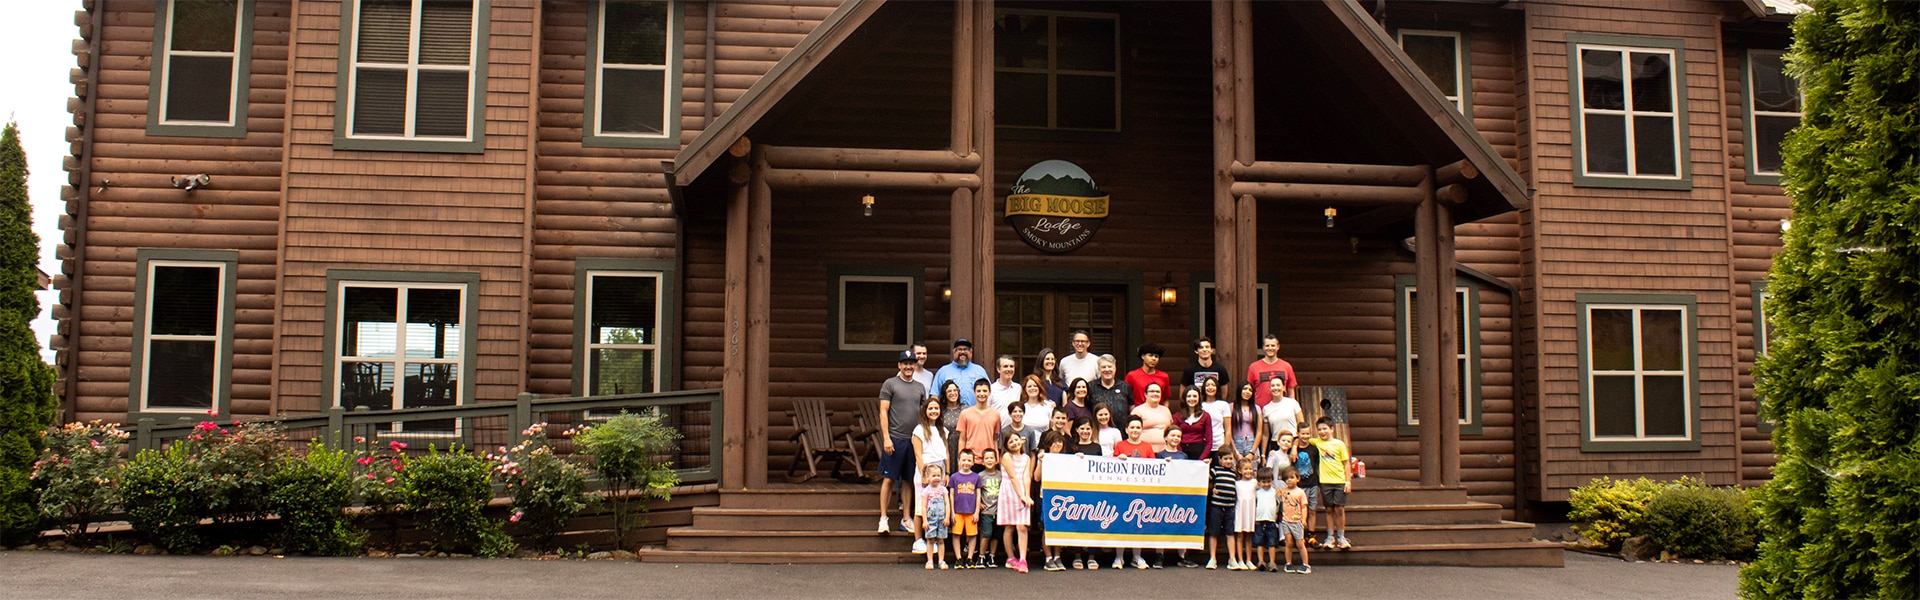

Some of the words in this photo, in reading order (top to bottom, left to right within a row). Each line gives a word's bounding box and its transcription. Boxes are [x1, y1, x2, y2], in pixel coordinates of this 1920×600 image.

[1011, 185, 1030, 194] The
[1009, 197, 1041, 212] BIG
[1047, 198, 1106, 214] MOOSE
[1031, 218, 1081, 234] Lodge
[1022, 227, 1048, 246] SMOKY
[1049, 228, 1091, 249] MOUNTAINS
[1087, 459, 1129, 475] PIGEON
[1131, 462, 1167, 477] FORGE
[1091, 474, 1162, 484] TENNESSEE
[1049, 494, 1119, 530] Family
[1122, 498, 1198, 528] Reunion
